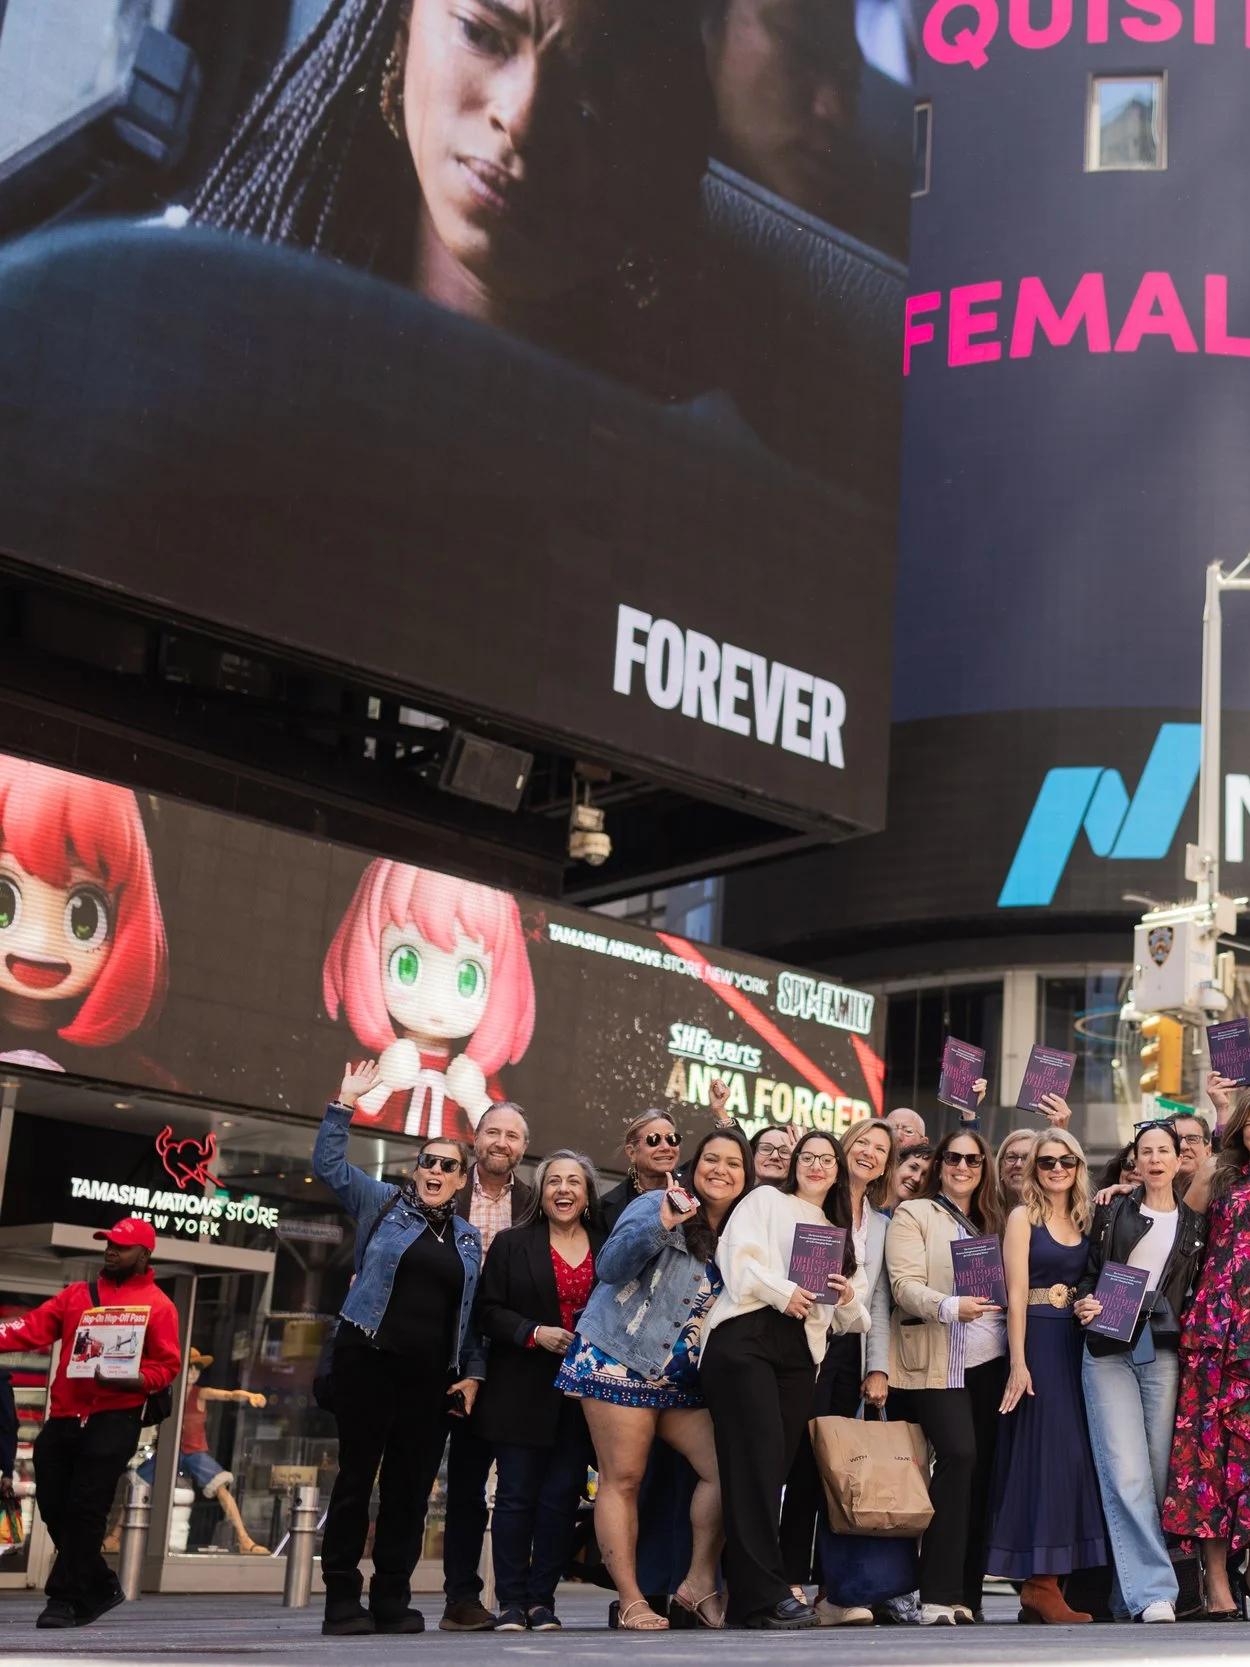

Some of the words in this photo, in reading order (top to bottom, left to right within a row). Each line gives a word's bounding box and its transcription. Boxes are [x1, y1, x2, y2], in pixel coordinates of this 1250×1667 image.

[613, 602, 847, 770] FOREVER
[548, 922, 609, 954] TAMASHII
[664, 953, 703, 980] STORE
[703, 964, 735, 987] NEW
[733, 972, 769, 997] YORK
[754, 1077, 873, 1136] FORGER
[70, 1177, 150, 1207] TAMASHII
[149, 1189, 223, 1218] NATIONS
[225, 1201, 280, 1229] STORE
[131, 1211, 168, 1230] NEW
[174, 1217, 221, 1237] YORK
[811, 1245, 828, 1259] THE
[970, 1256, 986, 1269] THE
[803, 1273, 828, 1292] WAY
[955, 1264, 1005, 1287] WHISPER
[970, 1282, 993, 1299] WAY
[1113, 1283, 1129, 1297] THE
[1094, 1290, 1140, 1315] WHISPER
[82, 1314, 105, 1325] Hop-On
[105, 1312, 130, 1325] Hop-Off
[130, 1312, 146, 1323] Pass
[1100, 1308, 1125, 1328] WAY
[849, 1455, 868, 1463] WITH
